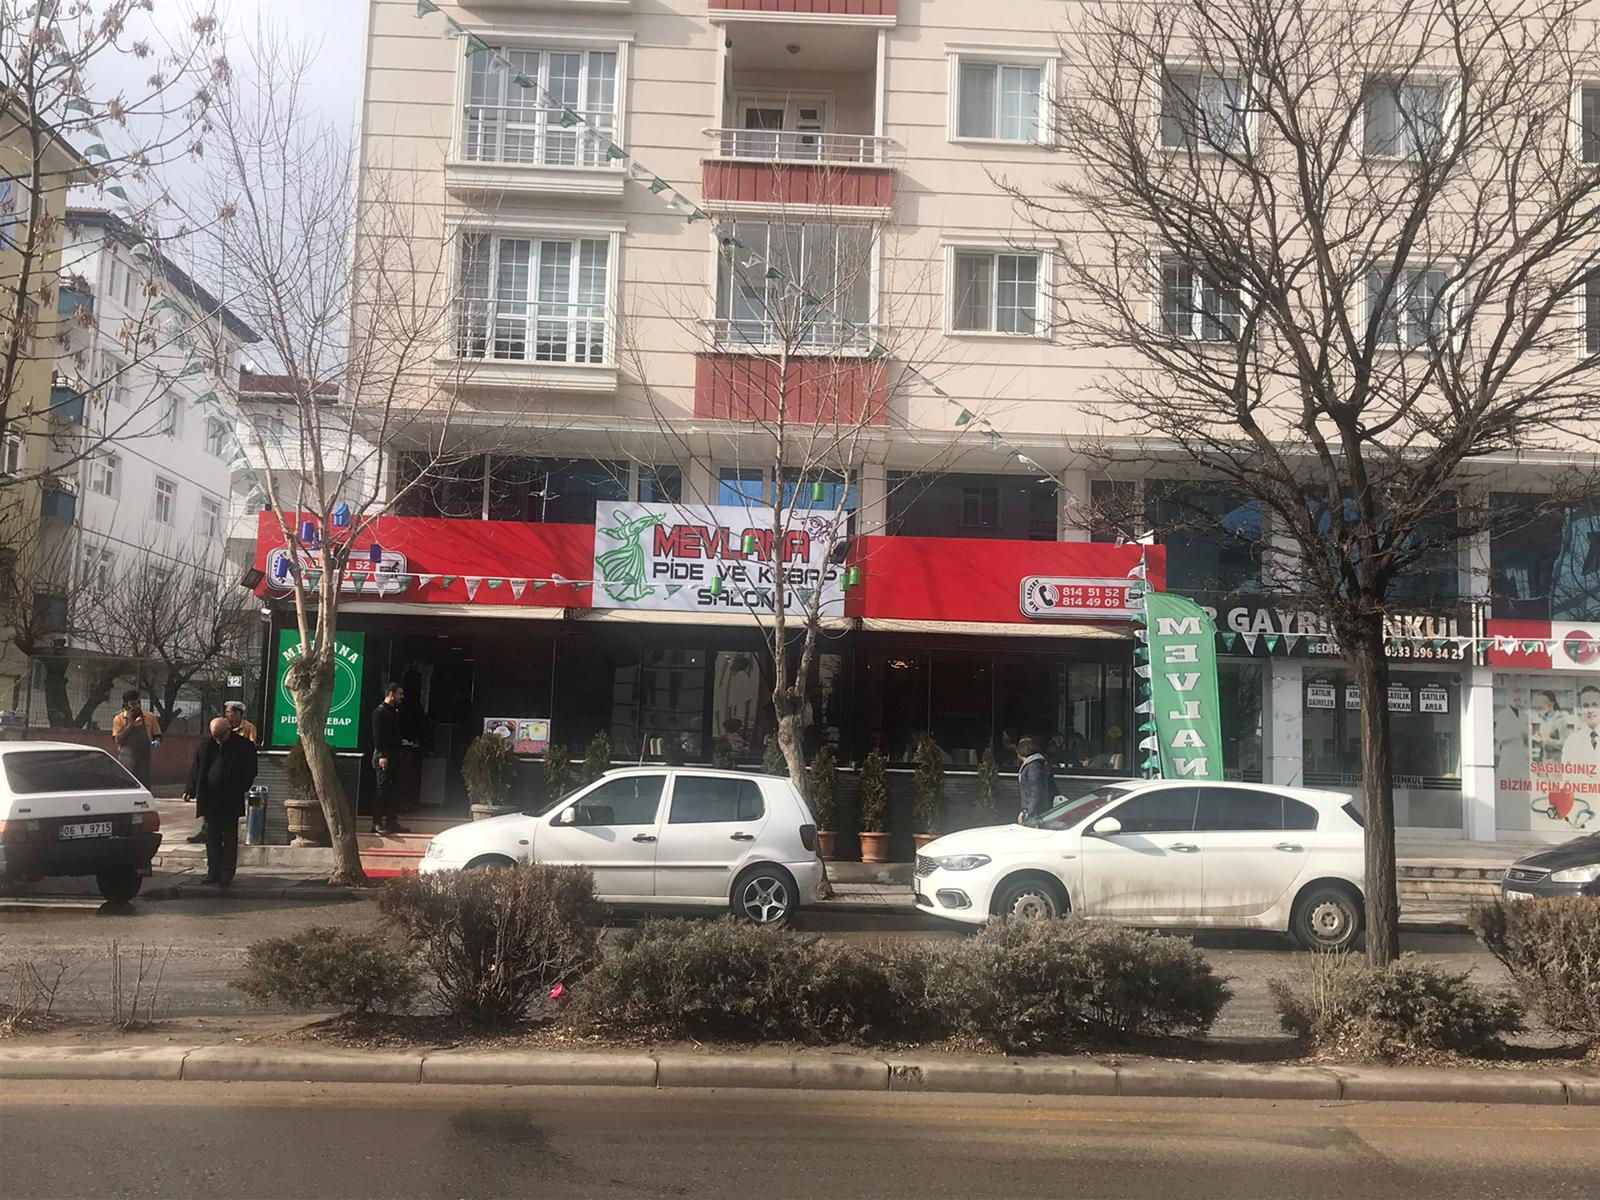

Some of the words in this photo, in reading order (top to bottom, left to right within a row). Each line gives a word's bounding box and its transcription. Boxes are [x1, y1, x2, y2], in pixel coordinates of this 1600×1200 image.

[355, 561, 371, 570] 52
[653, 558, 704, 580] PİDE
[716, 565, 746, 582] VE
[1062, 587, 1082, 596] 814
[1087, 588, 1100, 597] 51
[1104, 588, 1120, 597] 52
[1062, 597, 1082, 606] 814
[1085, 598, 1101, 607] 49
[1104, 598, 1120, 607] 09
[282, 640, 359, 664] MEVNA
[1435, 648, 1449, 660] 34
[1451, 649, 1465, 661] 29
[1388, 692, 1410, 700] ATILIK
[1389, 702, 1411, 710] ÜKKAN
[281, 714, 298, 724] PİD
[325, 717, 352, 726] EBAP
[1500, 777, 1533, 792] BİZİM
[64, 826, 75, 836] 06
[80, 825, 86, 834] Y
[89, 822, 112, 833] 9715
